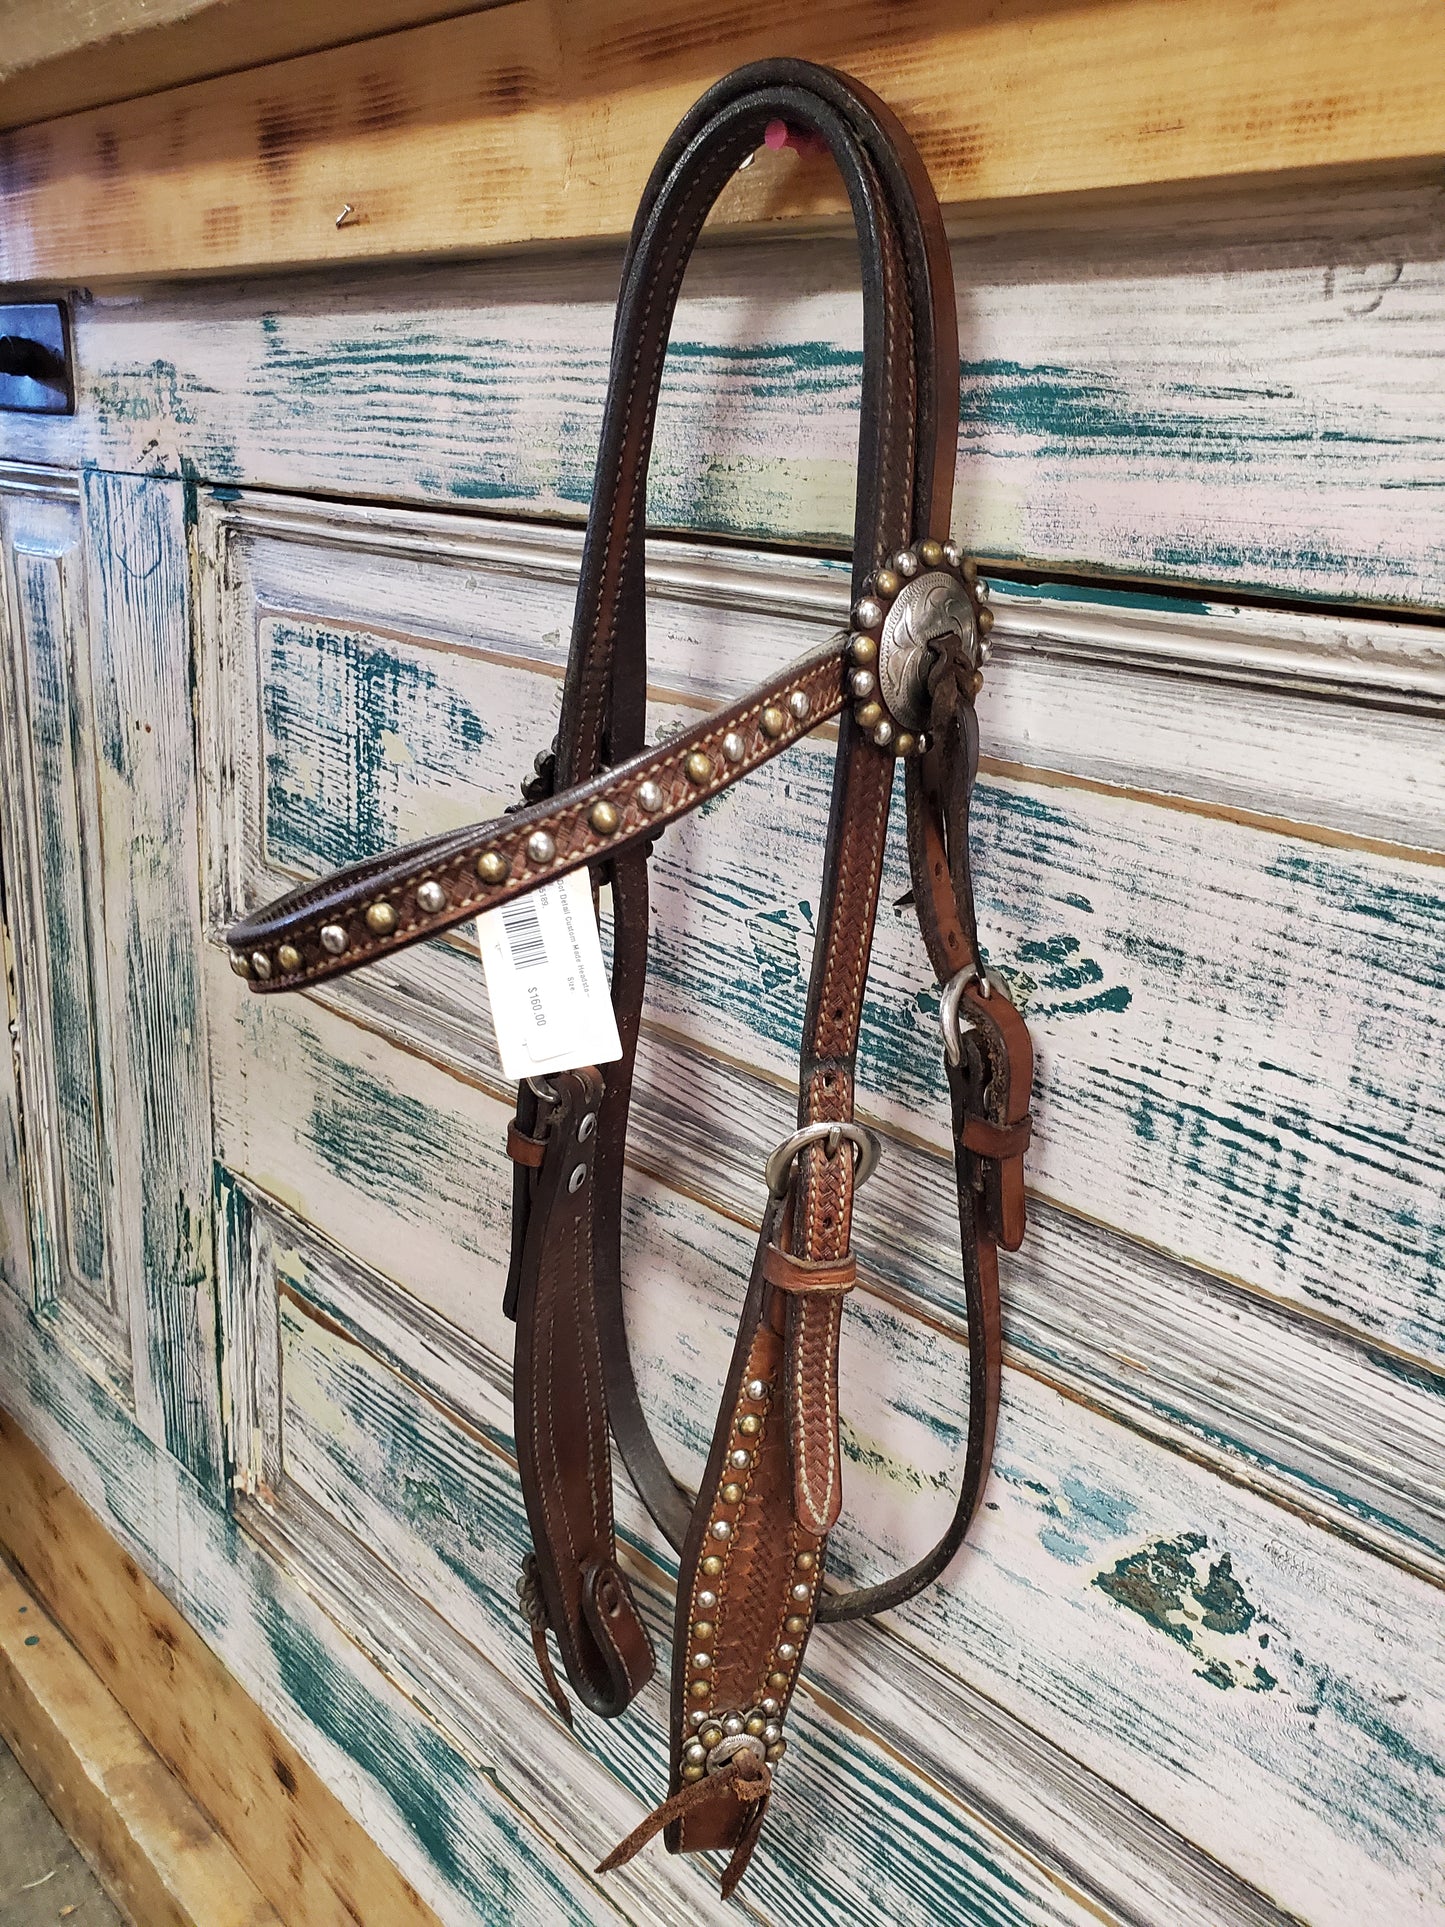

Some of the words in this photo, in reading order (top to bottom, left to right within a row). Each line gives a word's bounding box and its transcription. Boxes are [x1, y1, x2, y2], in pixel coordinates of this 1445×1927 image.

[557, 879, 566, 893] Dot
[559, 893, 571, 915] Detail
[565, 916, 576, 943] Custom
[572, 943, 582, 963] Made
[527, 986, 547, 1027] $160.00
